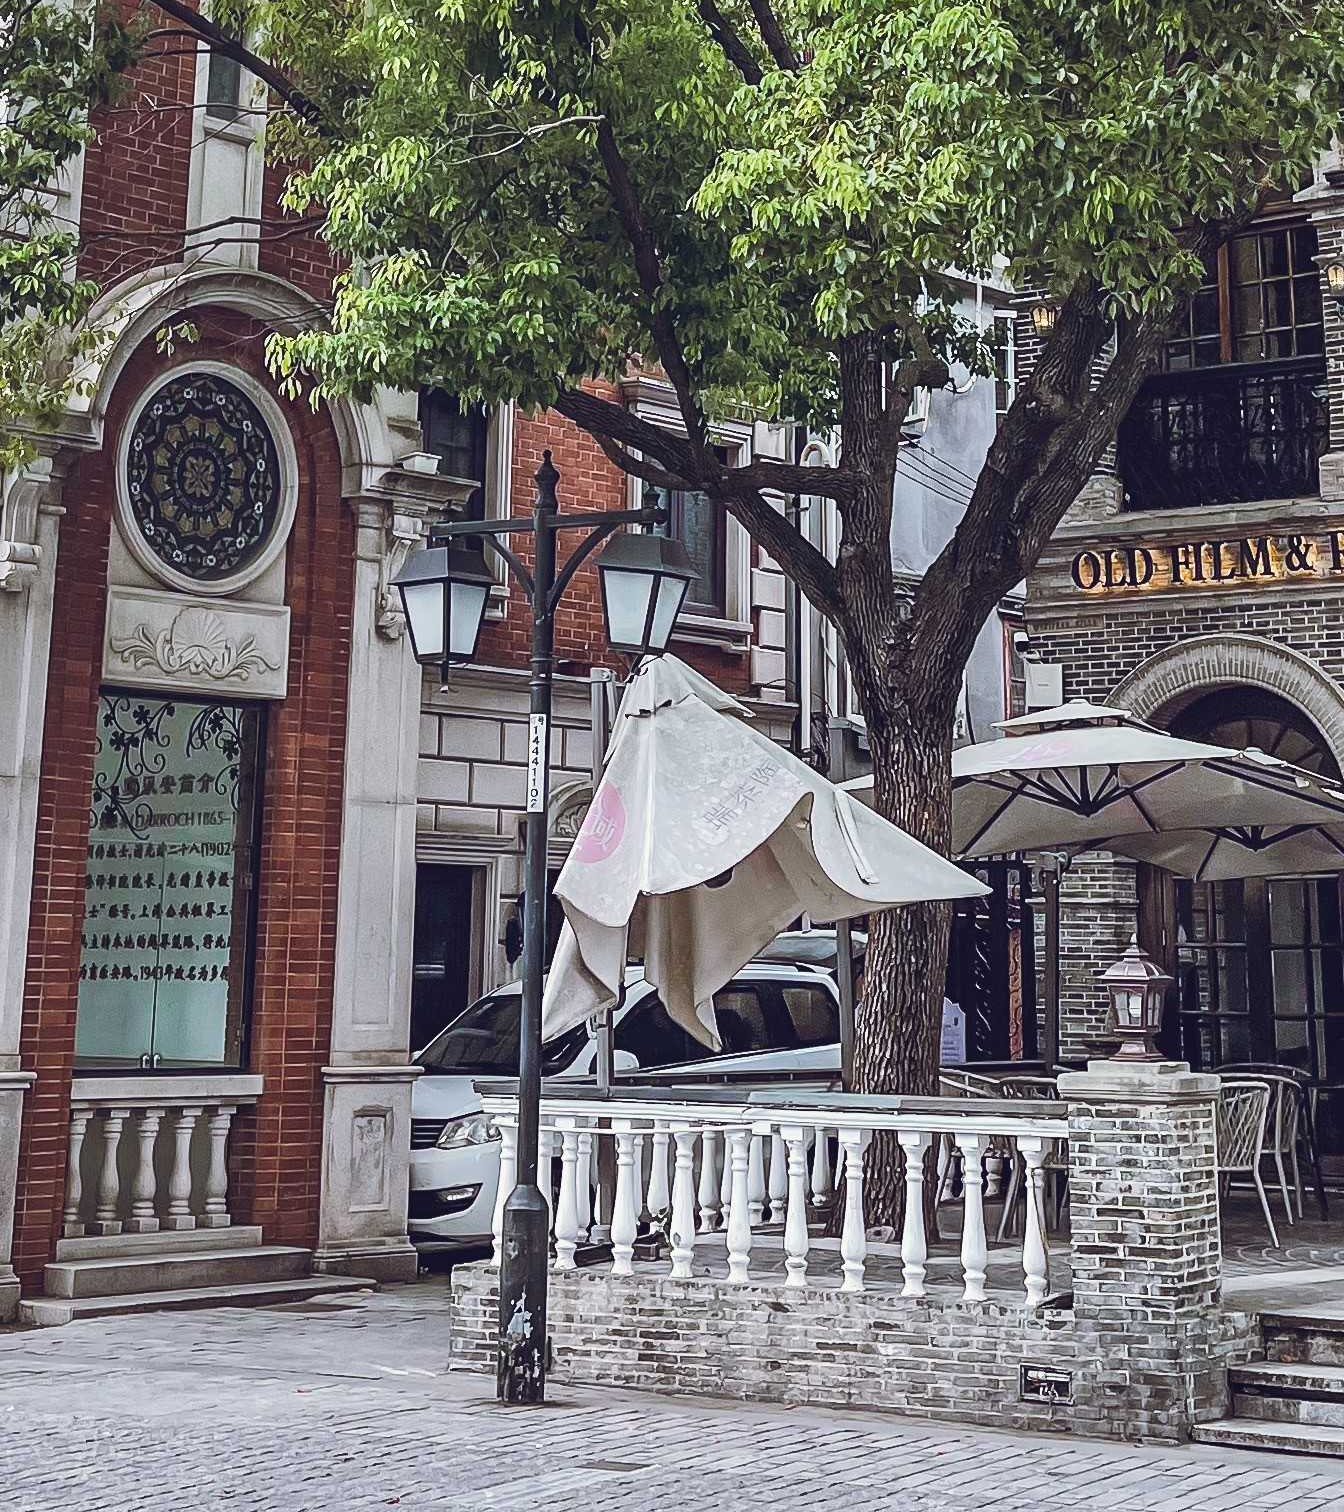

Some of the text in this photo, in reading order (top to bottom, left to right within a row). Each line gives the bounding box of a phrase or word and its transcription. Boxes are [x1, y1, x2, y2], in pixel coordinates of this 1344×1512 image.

[1071, 550, 1154, 589] OLD
[1168, 536, 1276, 584] FILM
[1284, 533, 1317, 573] &
